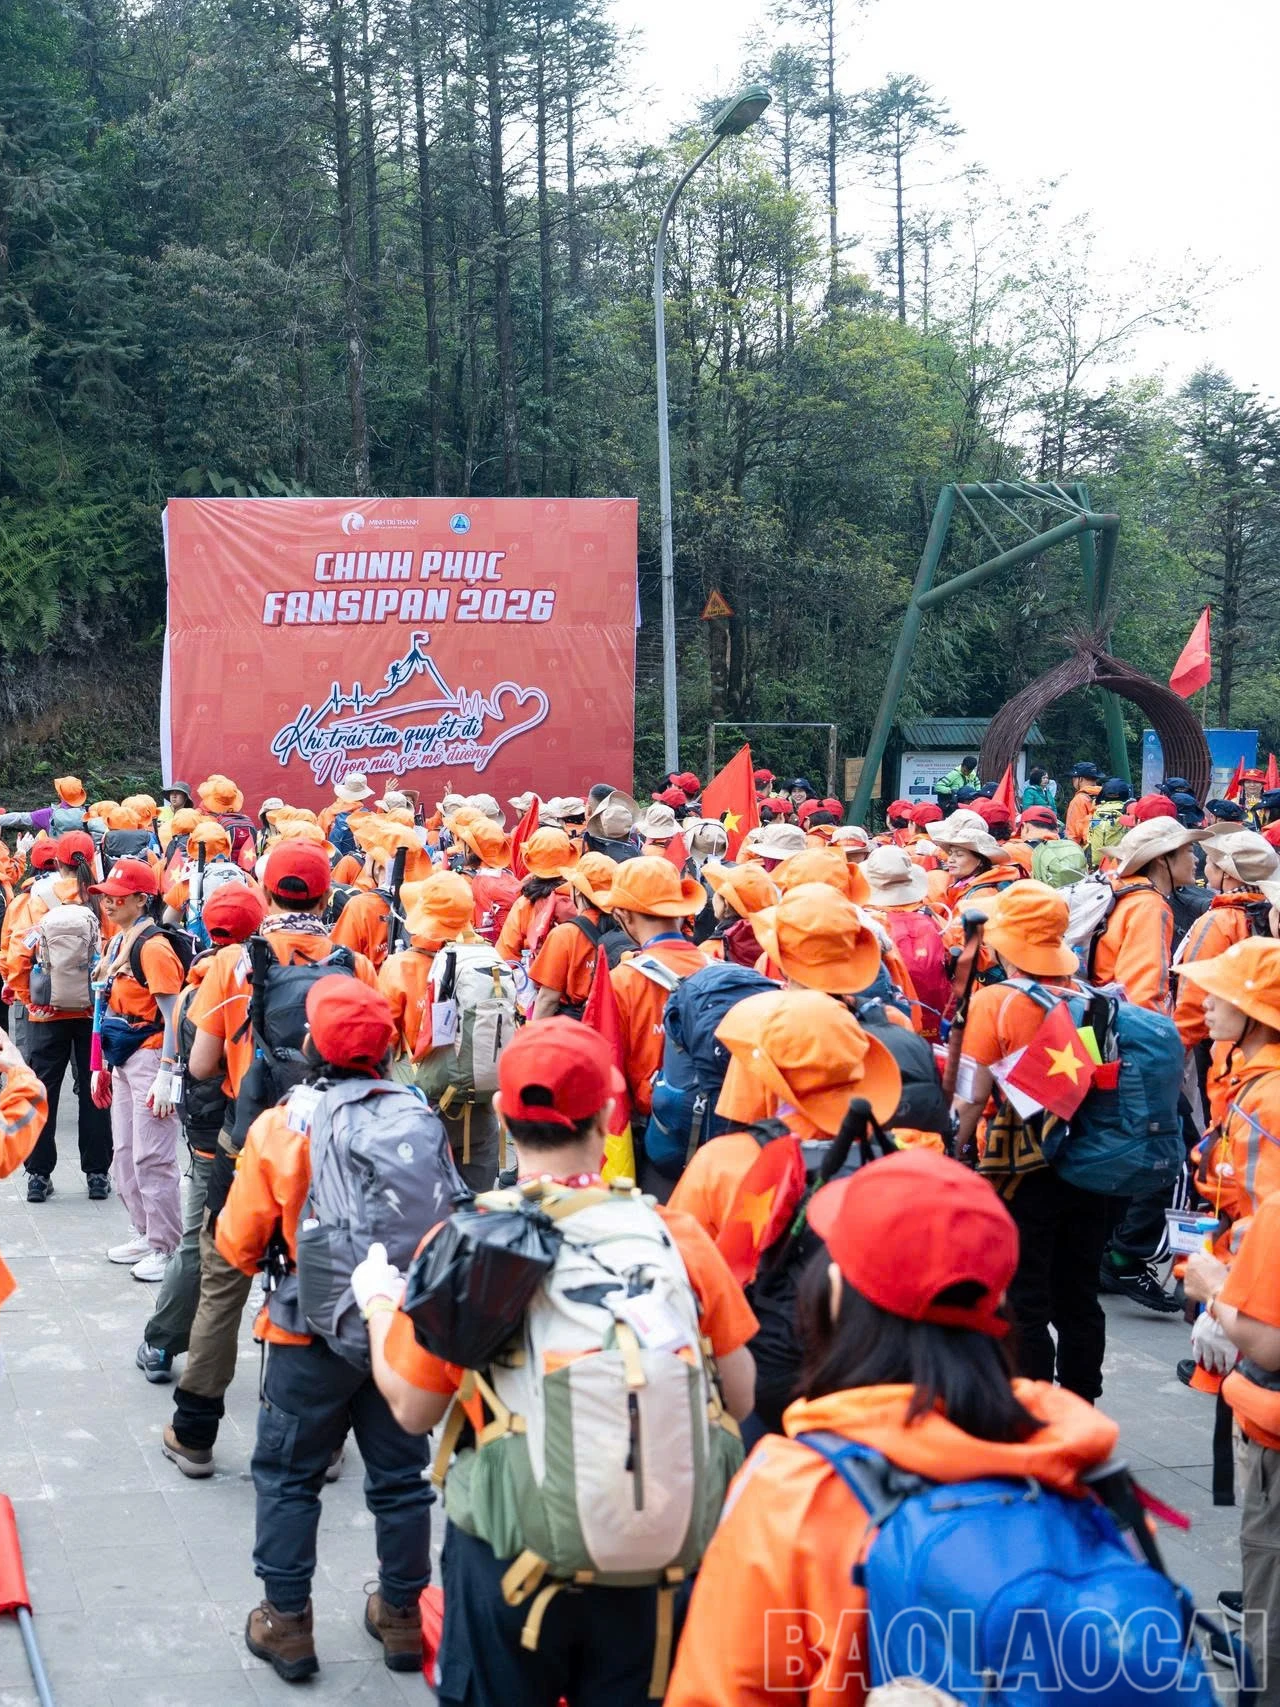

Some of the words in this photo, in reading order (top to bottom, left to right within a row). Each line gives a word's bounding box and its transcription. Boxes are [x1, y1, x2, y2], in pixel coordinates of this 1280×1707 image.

[315, 551, 413, 583] CHINH
[420, 551, 506, 586] PHỤC
[262, 589, 451, 625] FANSIPAN
[454, 588, 556, 624] 2026
[273, 706, 324, 763] Khi
[327, 726, 365, 750] trái
[369, 725, 400, 745] tim
[404, 717, 457, 754] quyết
[462, 717, 480, 737] đi
[370, 751, 396, 771] núi
[398, 752, 418, 772] sẽ
[421, 744, 444, 765] mở
[447, 741, 489, 770] đường
